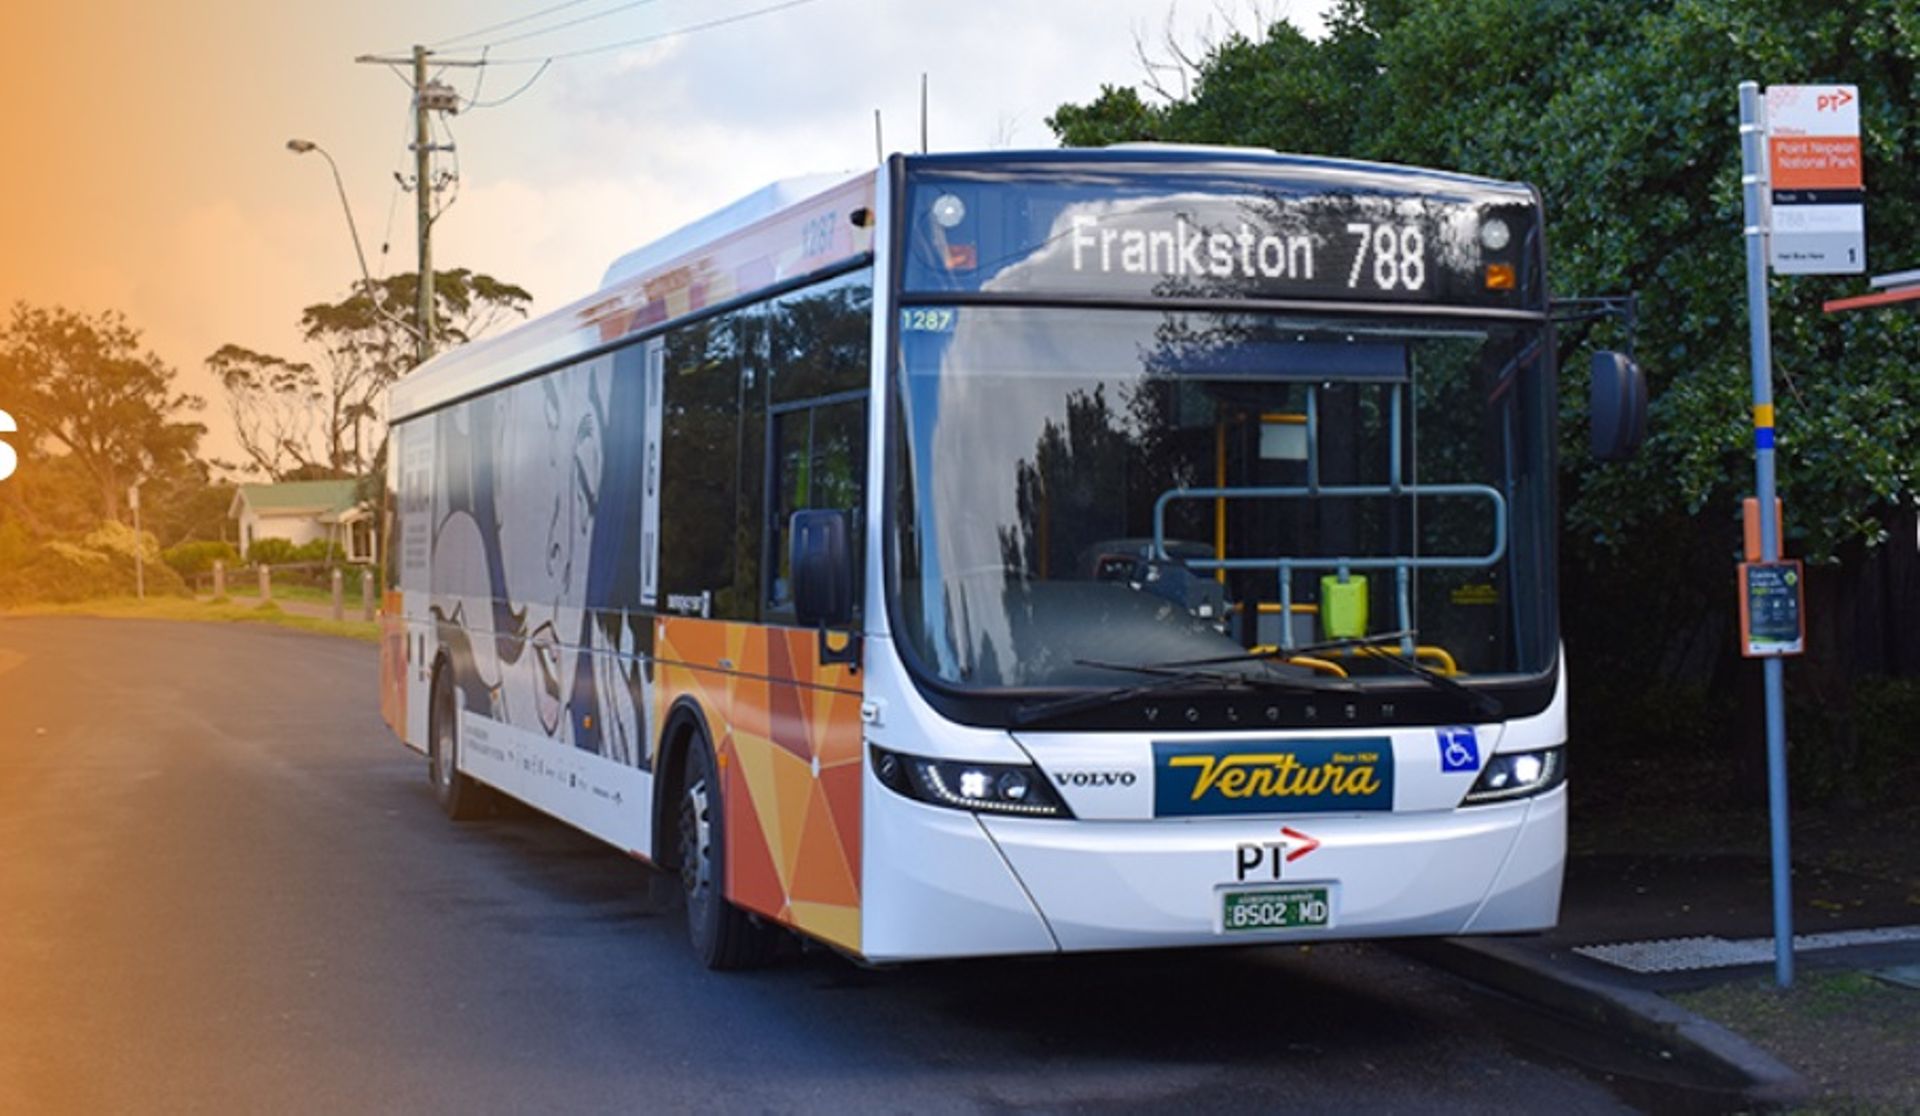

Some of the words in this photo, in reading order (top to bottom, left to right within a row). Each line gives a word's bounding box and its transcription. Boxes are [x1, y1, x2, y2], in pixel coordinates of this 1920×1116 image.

[1778, 156, 1825, 169] National
[1829, 154, 1857, 168] Park
[801, 209, 837, 257] 1287
[1070, 215, 1314, 280] Frankston
[1346, 222, 1426, 291] 788
[902, 310, 951, 331] 1287
[1144, 703, 1397, 722] VOLGREN
[1053, 771, 1137, 787] VOLVO
[1168, 753, 1380, 801] Ventura
